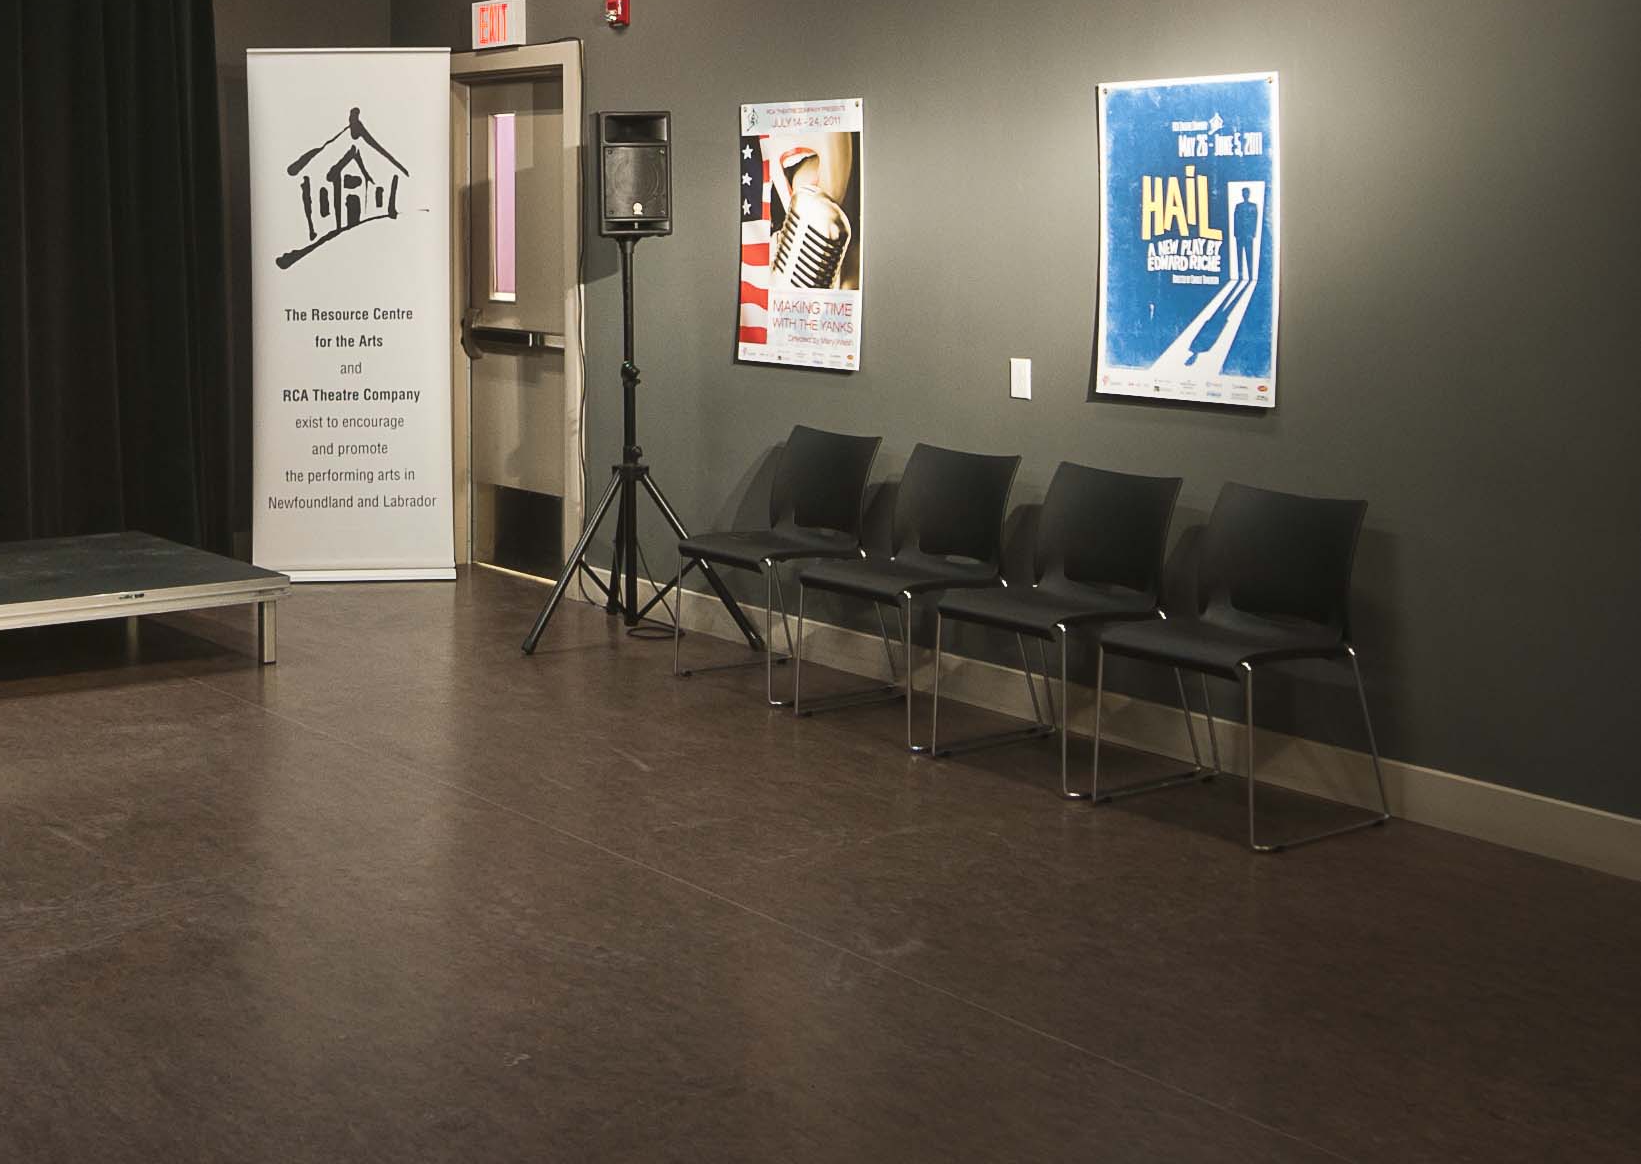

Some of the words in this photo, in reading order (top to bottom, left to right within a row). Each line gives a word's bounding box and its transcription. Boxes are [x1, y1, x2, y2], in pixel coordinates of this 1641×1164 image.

[478, 3, 508, 46] EXIT
[823, 116, 841, 126] 2011
[1148, 242, 1157, 256] A
[1158, 238, 1179, 255] NEW
[1181, 238, 1206, 256] PLAY
[1206, 239, 1222, 256] BY
[1147, 254, 1189, 272] EDWARD
[1189, 254, 1221, 272] RICHE
[284, 308, 308, 322] The
[311, 308, 369, 321] Resource
[373, 307, 414, 321] Centre
[772, 299, 821, 315] MAKING
[823, 301, 853, 317] TIME
[772, 317, 796, 329] WITH
[799, 318, 818, 331] THE
[820, 320, 854, 334] YANKS
[315, 335, 333, 348] for
[336, 334, 355, 348] the
[358, 334, 384, 348] Arts
[340, 362, 363, 375] and
[283, 388, 309, 403] RCA
[312, 388, 360, 402] Theatre
[363, 387, 421, 404] Company
[295, 415, 323, 429] exist
[326, 416, 339, 429] to
[342, 416, 405, 430] encourage
[311, 442, 334, 456] and
[337, 442, 389, 457] promote
[285, 469, 304, 483] the
[308, 468, 374, 484] performing
[377, 468, 401, 481] arts
[404, 468, 416, 481] in
[268, 495, 354, 510] Newfoundland
[357, 494, 379, 508] and
[383, 494, 437, 508] Labrador
